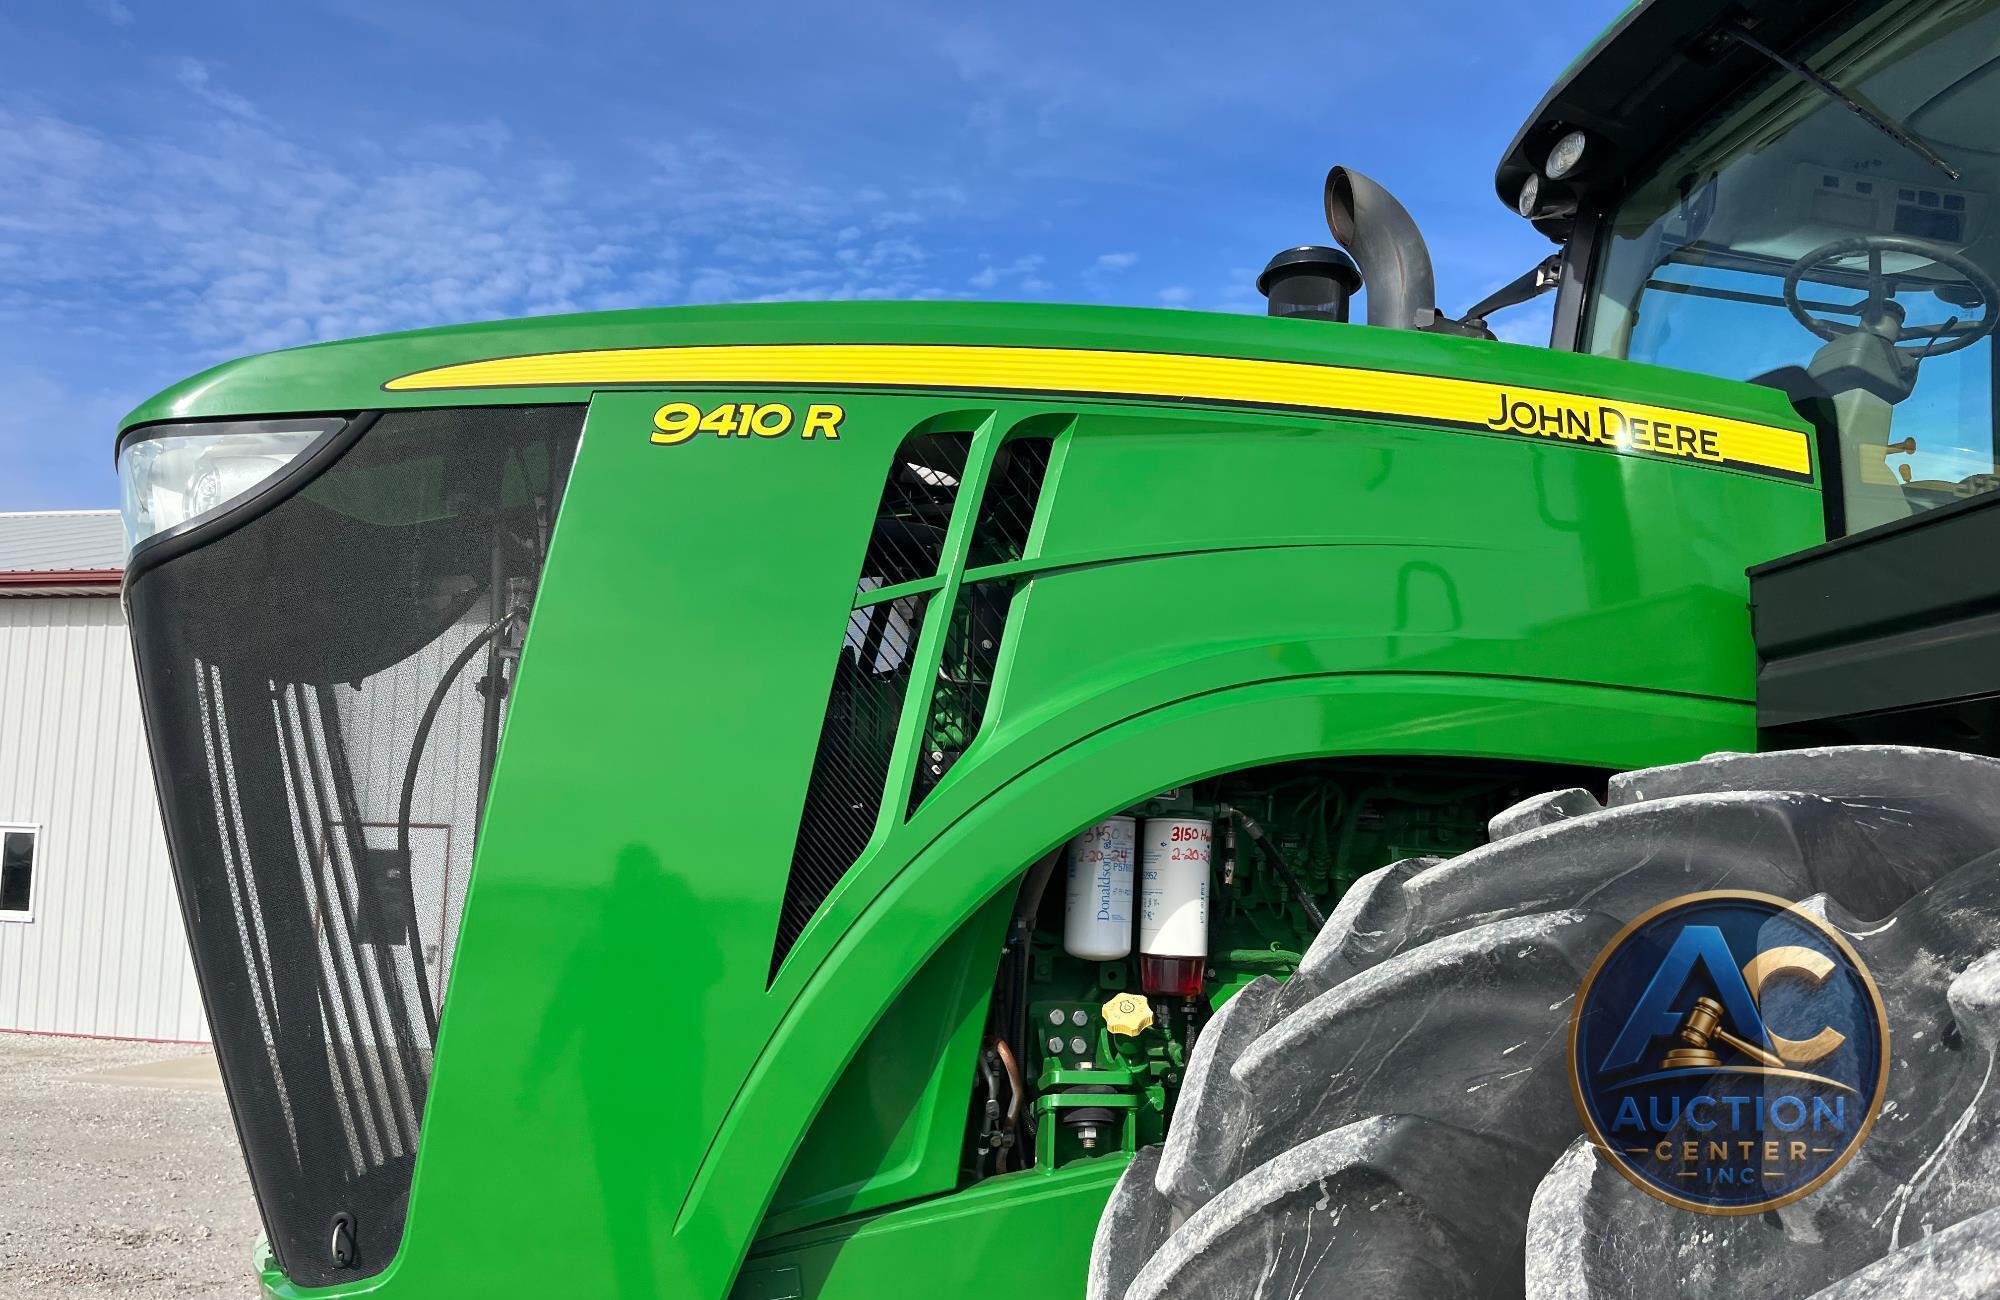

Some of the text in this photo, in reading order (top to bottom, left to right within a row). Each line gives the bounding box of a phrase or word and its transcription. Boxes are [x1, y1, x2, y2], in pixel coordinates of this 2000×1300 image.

[650, 402, 846, 446] 9410 R
[1488, 393, 1720, 457] JOHN DEERE
[1170, 826, 1199, 842] 3150
[1097, 854, 1112, 921] Donaldson
